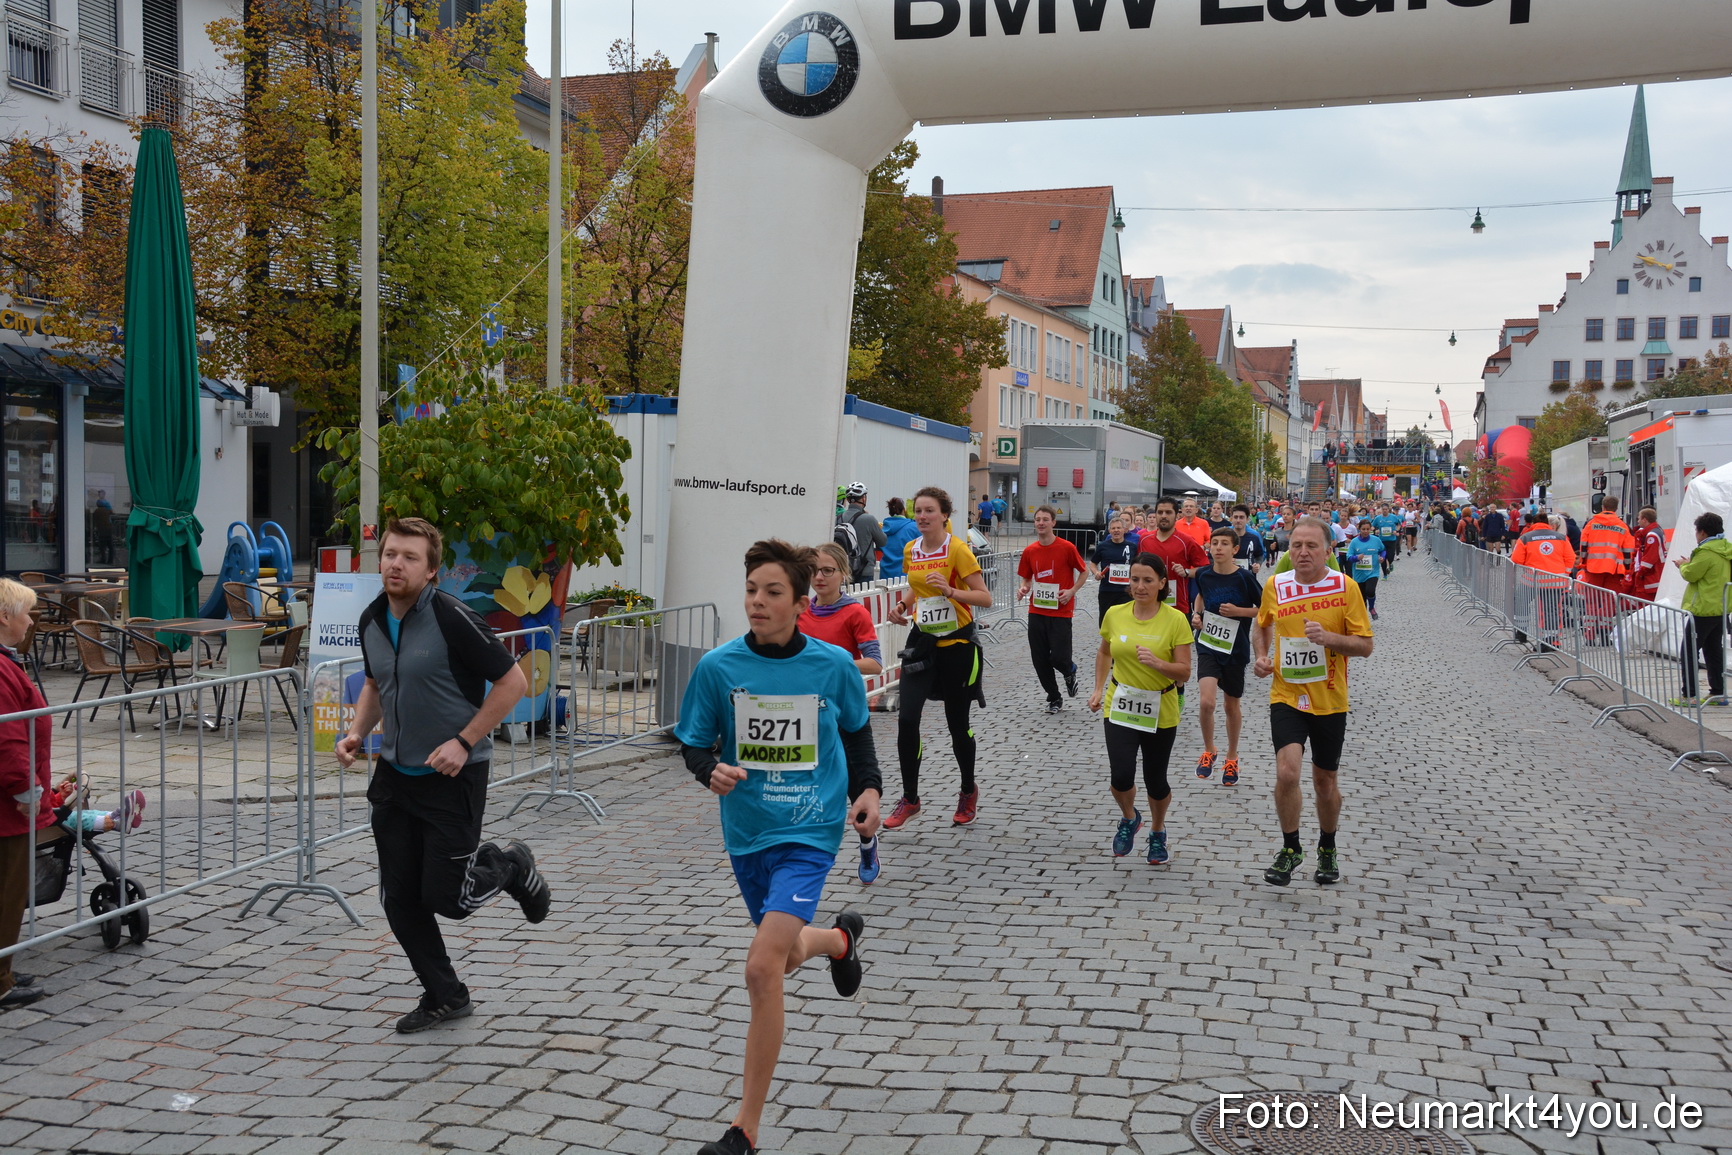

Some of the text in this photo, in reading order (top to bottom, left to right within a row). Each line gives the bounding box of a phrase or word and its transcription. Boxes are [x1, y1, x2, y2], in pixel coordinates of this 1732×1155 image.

[1, 308, 36, 336] City
[1001, 441, 1014, 453] D
[1593, 524, 1624, 533] NOTARZT
[928, 561, 949, 569] BÖGL
[1036, 590, 1055, 599] 5154
[922, 608, 950, 623] 5177
[1277, 598, 1347, 619] MAX BÖGL
[1206, 622, 1231, 639] 5015
[1285, 651, 1318, 665] 5176
[1118, 698, 1152, 714] 5115
[748, 718, 801, 741] 5271
[740, 745, 801, 762] MORRIS
[763, 783, 811, 793] Neumarkter
[762, 793, 801, 803] Stadtlauf
